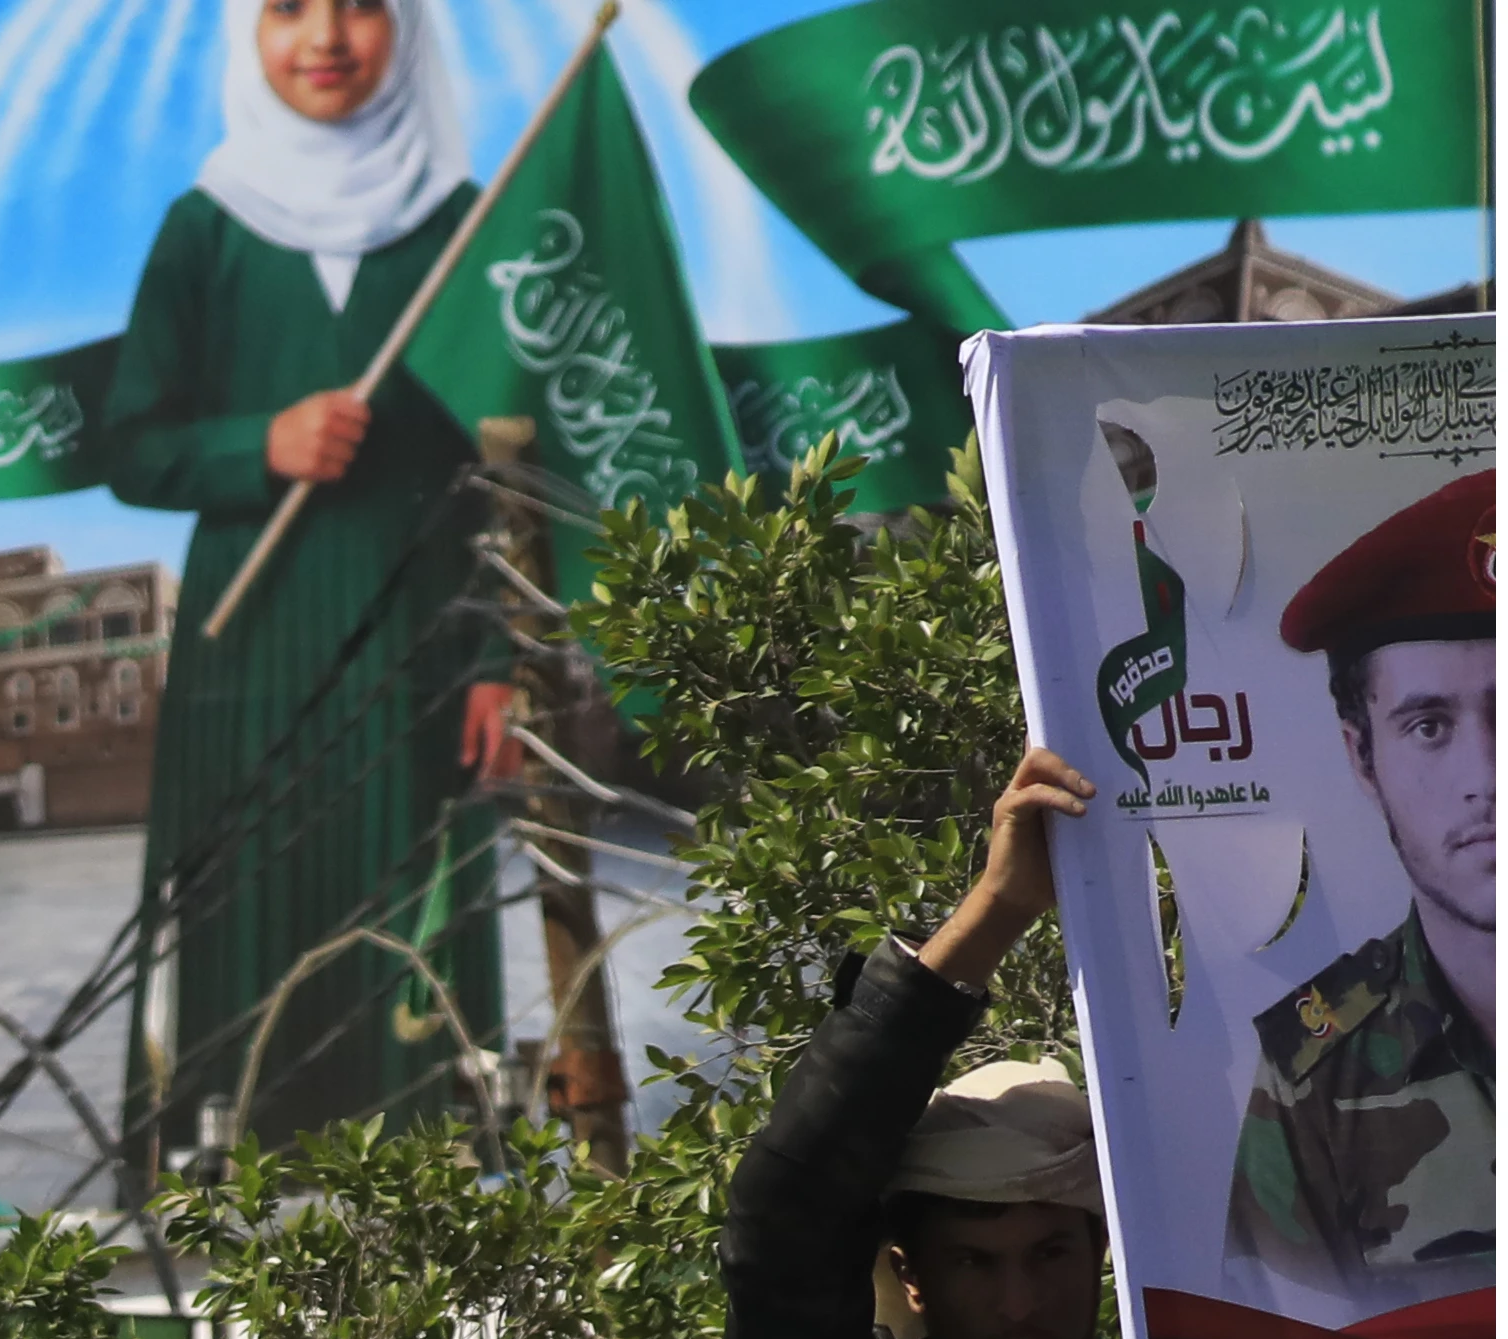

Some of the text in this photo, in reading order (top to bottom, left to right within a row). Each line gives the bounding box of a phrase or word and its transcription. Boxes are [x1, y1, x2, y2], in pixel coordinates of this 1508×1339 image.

[1108, 645, 1175, 708] صدقوا
[1131, 688, 1253, 762] رجال
[1116, 778, 1270, 815] ما عاهدوا الله عليه
